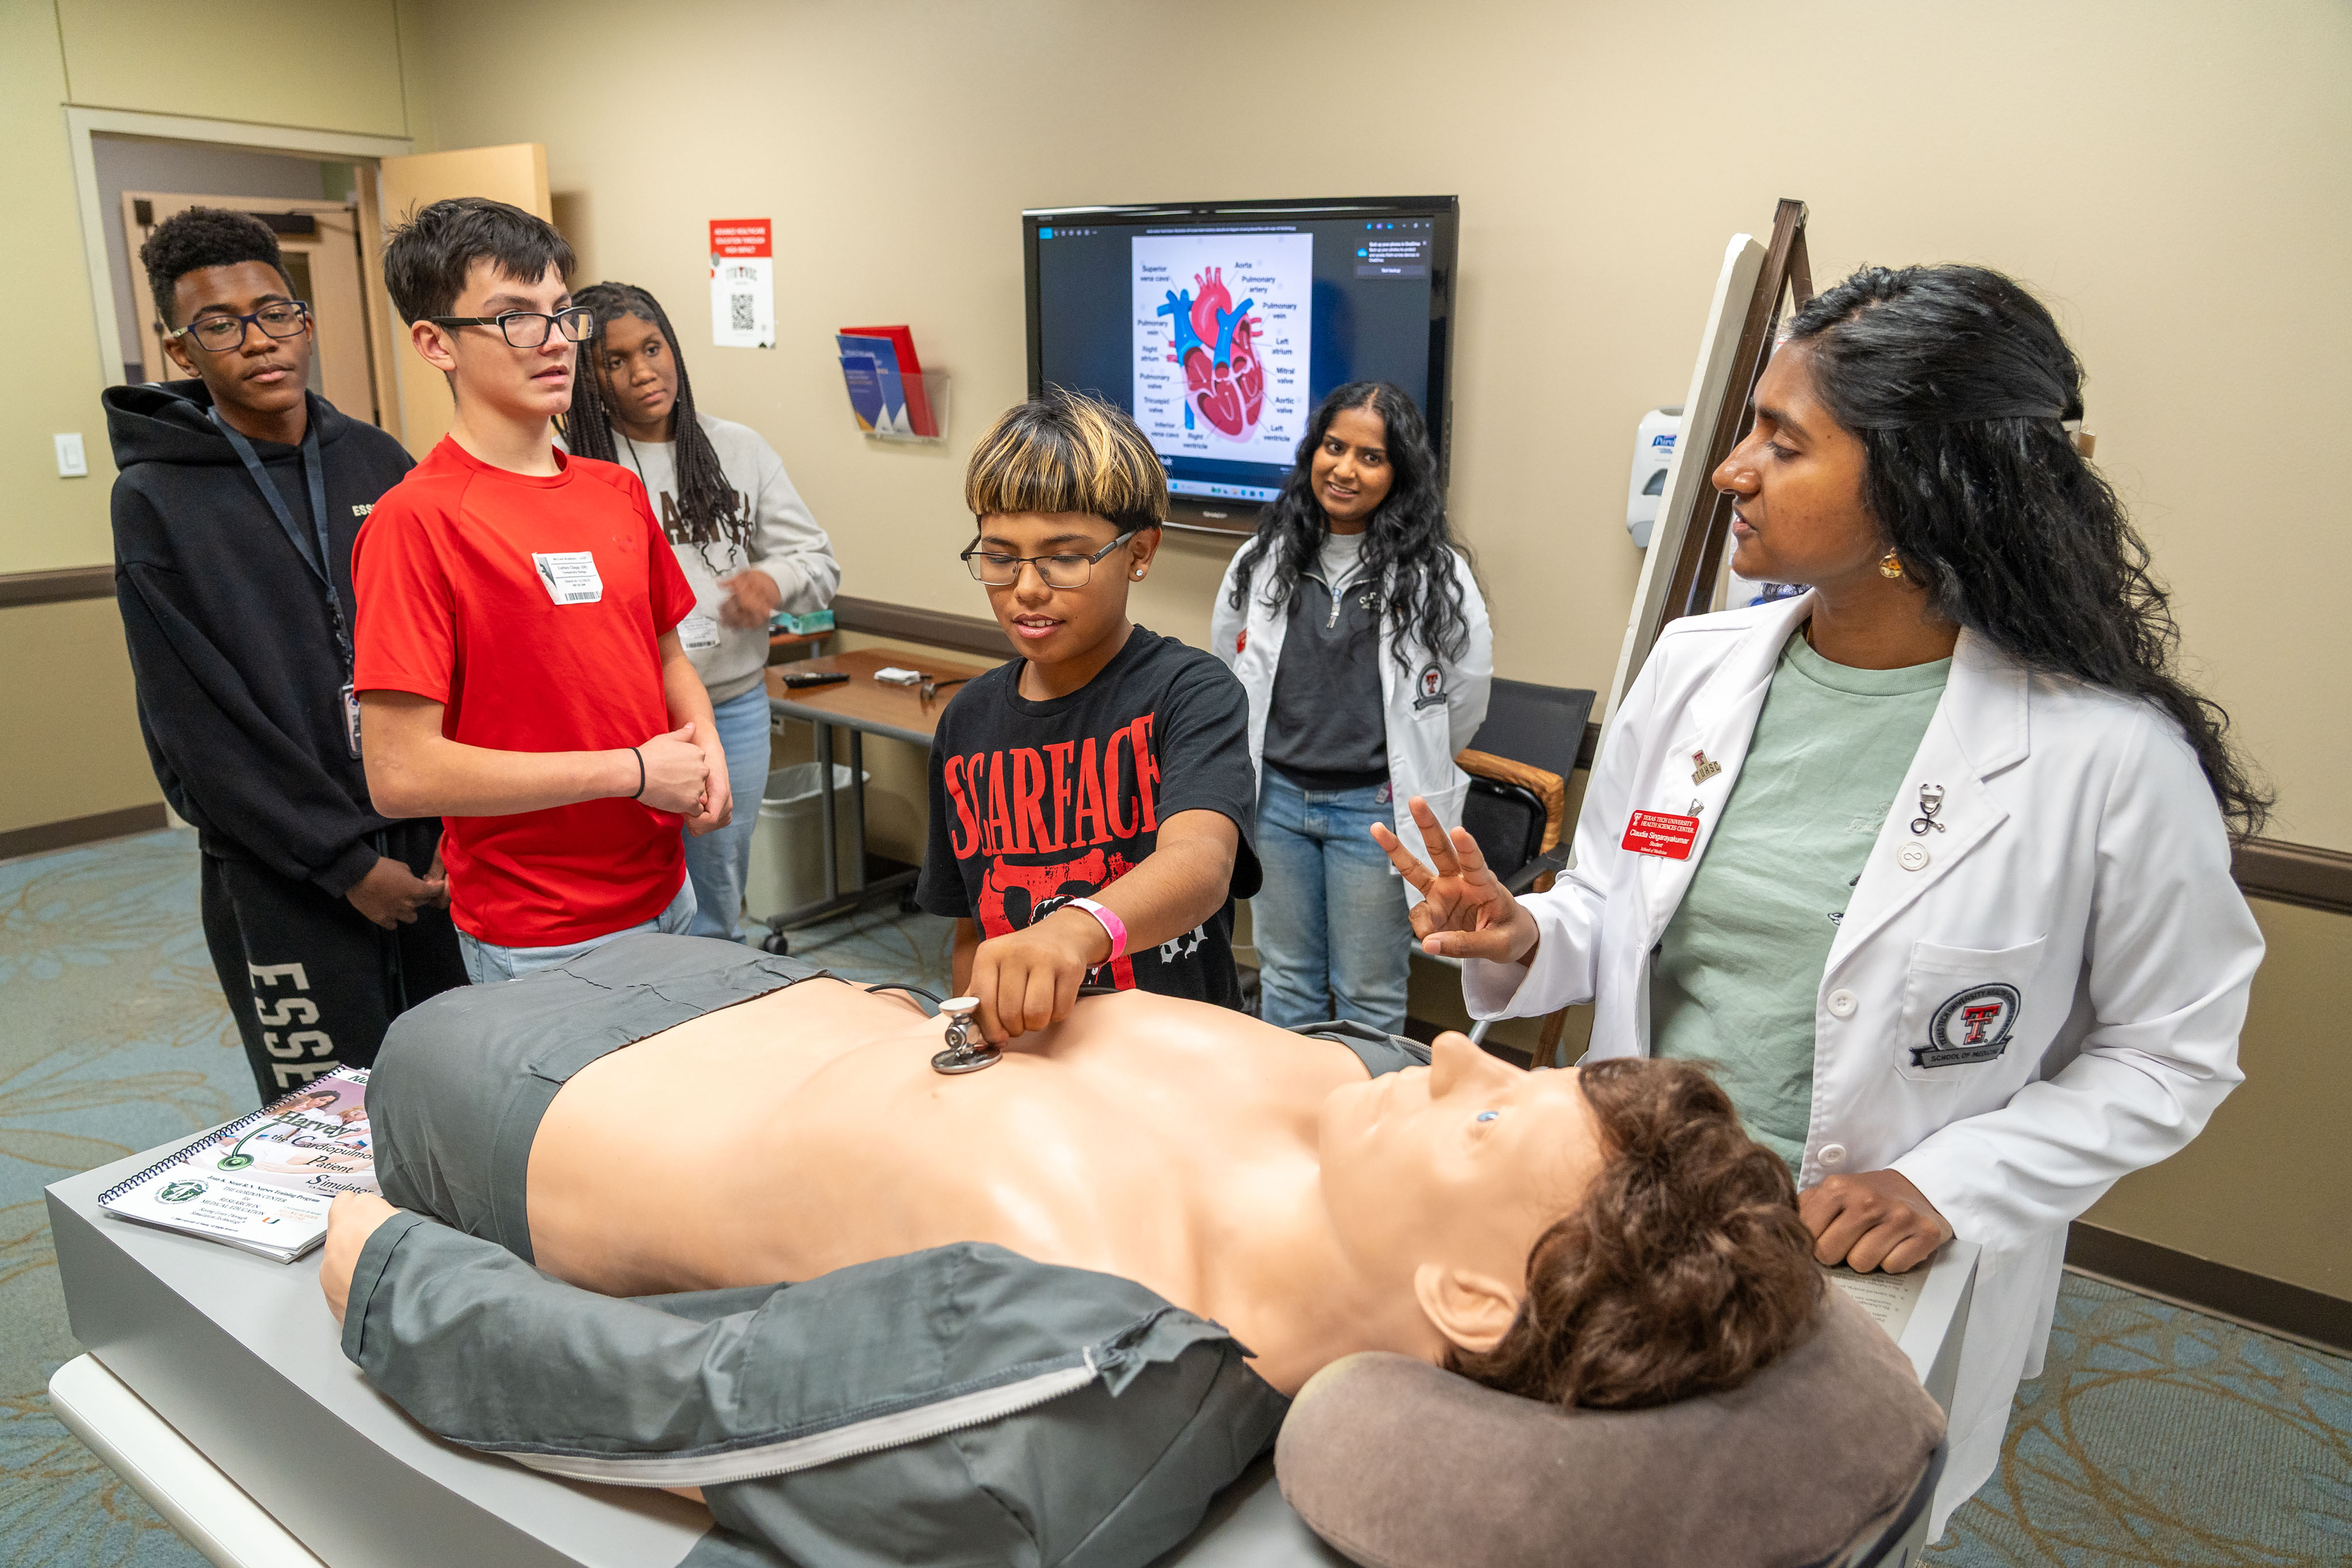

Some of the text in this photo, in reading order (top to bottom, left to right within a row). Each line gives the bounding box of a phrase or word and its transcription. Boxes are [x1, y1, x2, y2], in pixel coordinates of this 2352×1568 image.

[1241, 276, 1275, 284] Pulmonary
[1263, 303, 1297, 311] Pulmonary
[1138, 320, 1168, 328] Pulmonary
[352, 504, 375, 517] ESS
[1692, 762, 1720, 783] TTUHSC
[944, 712, 1161, 860] SCARFACE
[1657, 823, 1677, 831] SCIENCES
[1668, 818, 1693, 827] UNIVERSITY
[1630, 829, 1689, 844] Claudia Singarayakumar
[272, 1134, 288, 1142] the
[303, 1155, 354, 1173] Patient
[219, 1197, 253, 1207] RESEARCH
[236, 1188, 261, 1198] GORDON
[262, 1194, 287, 1203] CENTER
[275, 1190, 296, 1198] Training
[296, 1195, 320, 1203] Program
[200, 1199, 266, 1215] MEDICAL EDUCATION
